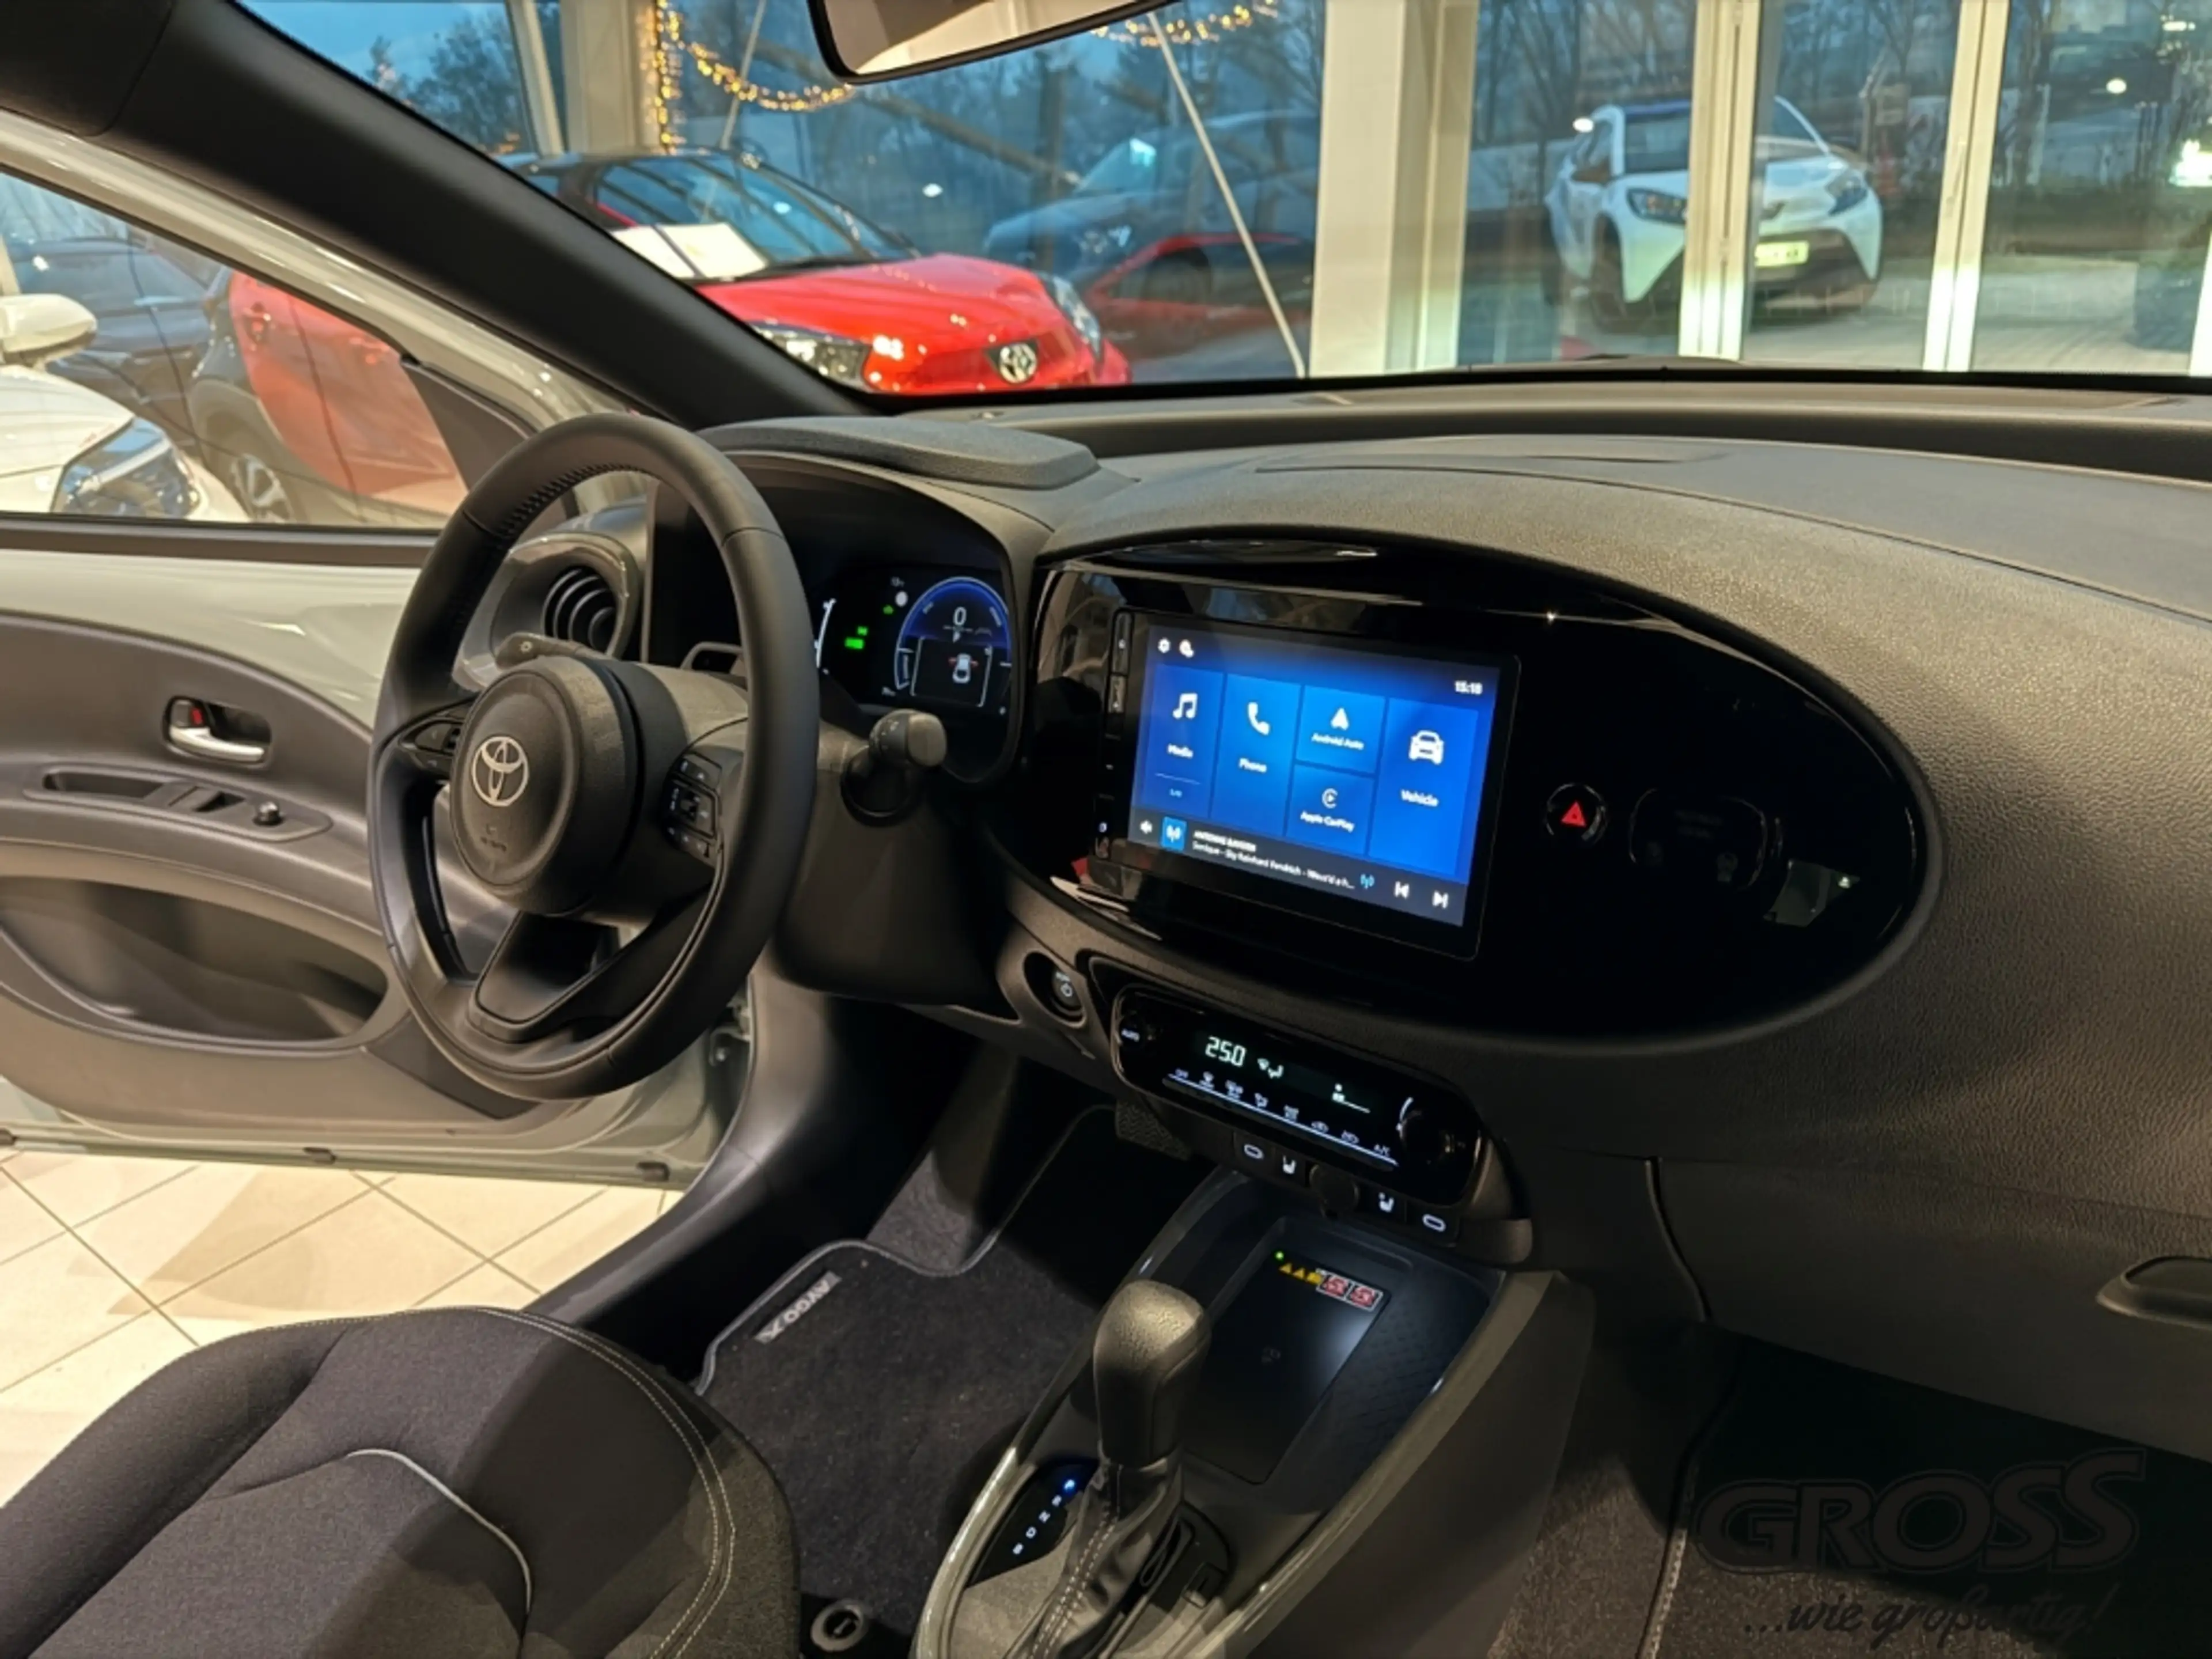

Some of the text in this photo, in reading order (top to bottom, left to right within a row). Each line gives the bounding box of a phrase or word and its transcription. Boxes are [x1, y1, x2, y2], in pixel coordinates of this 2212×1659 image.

[1311, 732, 1365, 750] Android Auto
[1167, 743, 1194, 759] Media
[1238, 757, 1267, 773] Phone
[1400, 789, 1439, 807] Vehicle
[1300, 810, 1355, 833] Apple CarPlay
